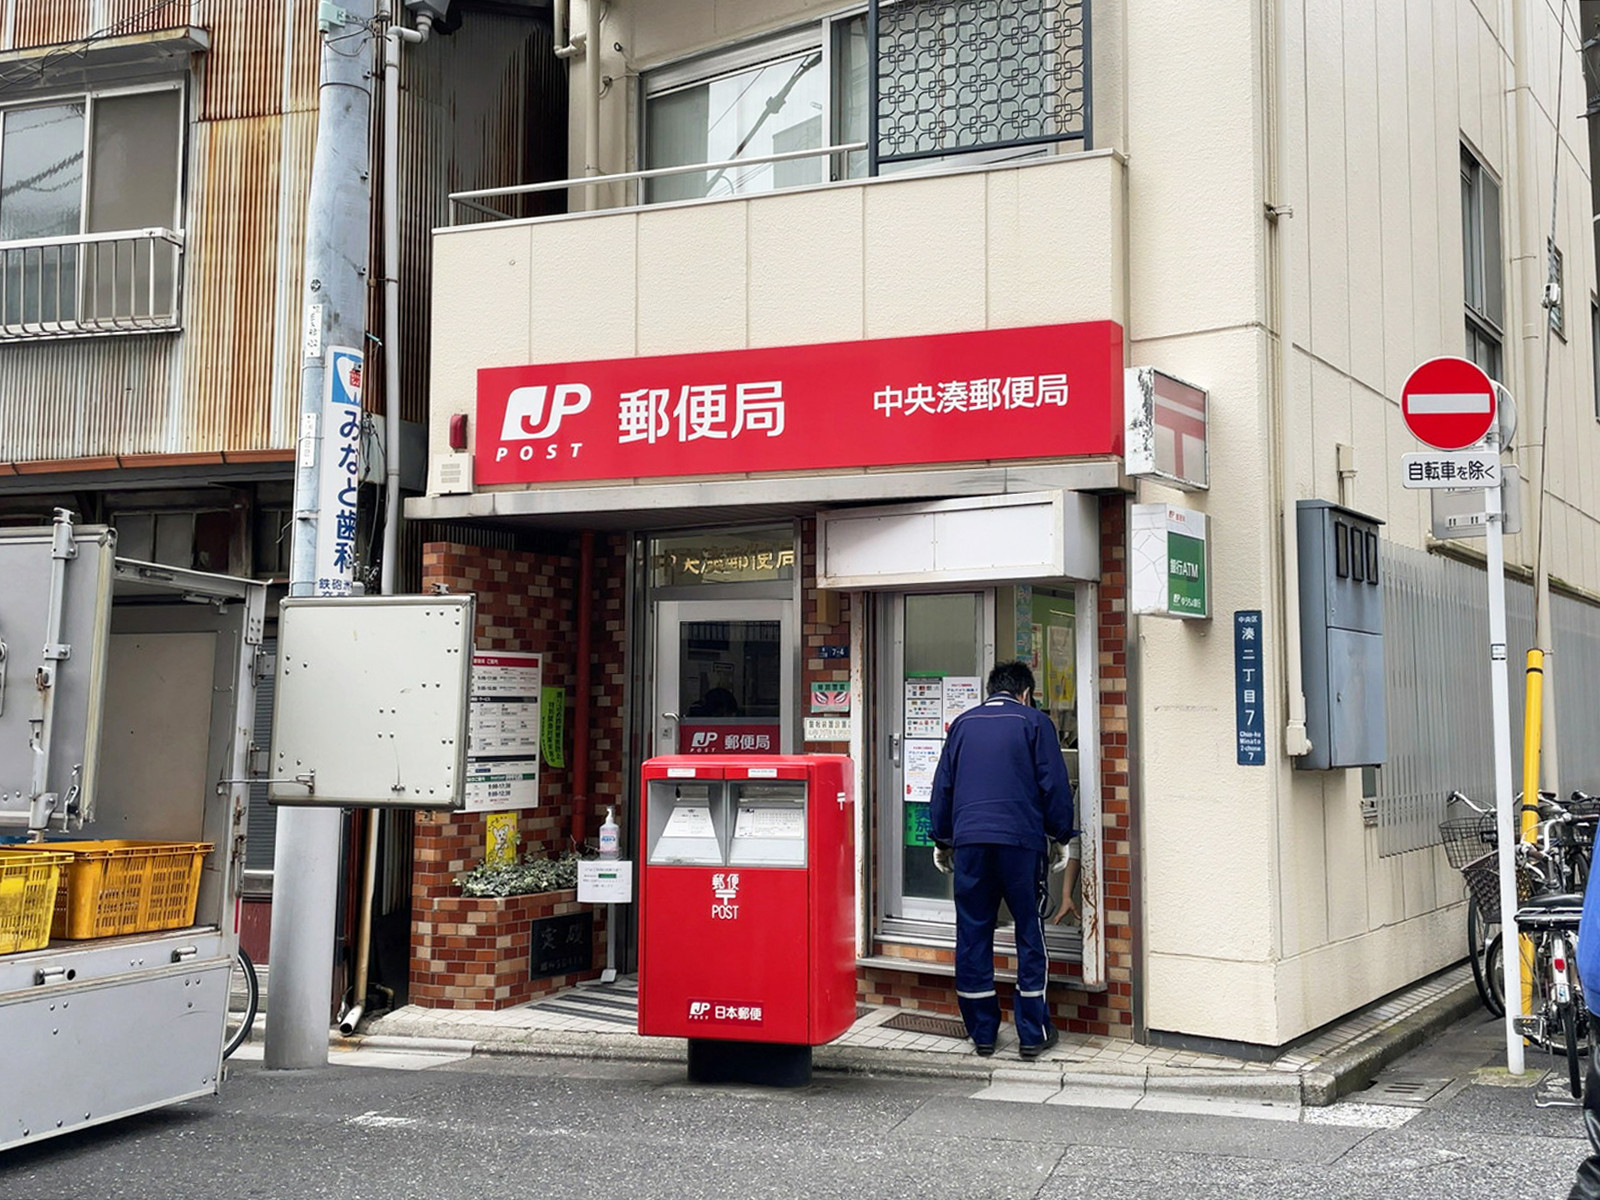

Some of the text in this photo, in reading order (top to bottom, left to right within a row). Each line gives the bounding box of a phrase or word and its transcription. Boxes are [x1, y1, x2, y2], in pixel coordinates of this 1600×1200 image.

[873, 373, 1069, 418] 中央湊郵便局
[617, 380, 785, 444] 郵便局
[495, 443, 583, 462] POST
[1408, 460, 1495, 481] 自転車を除く
[333, 410, 361, 574] みなと歯科
[724, 734, 771, 750] 郵便局
[1248, 752, 1254, 761] 7
[711, 873, 740, 890] 郵便
[711, 904, 739, 920] POST
[714, 1005, 762, 1021] 日本郵便
